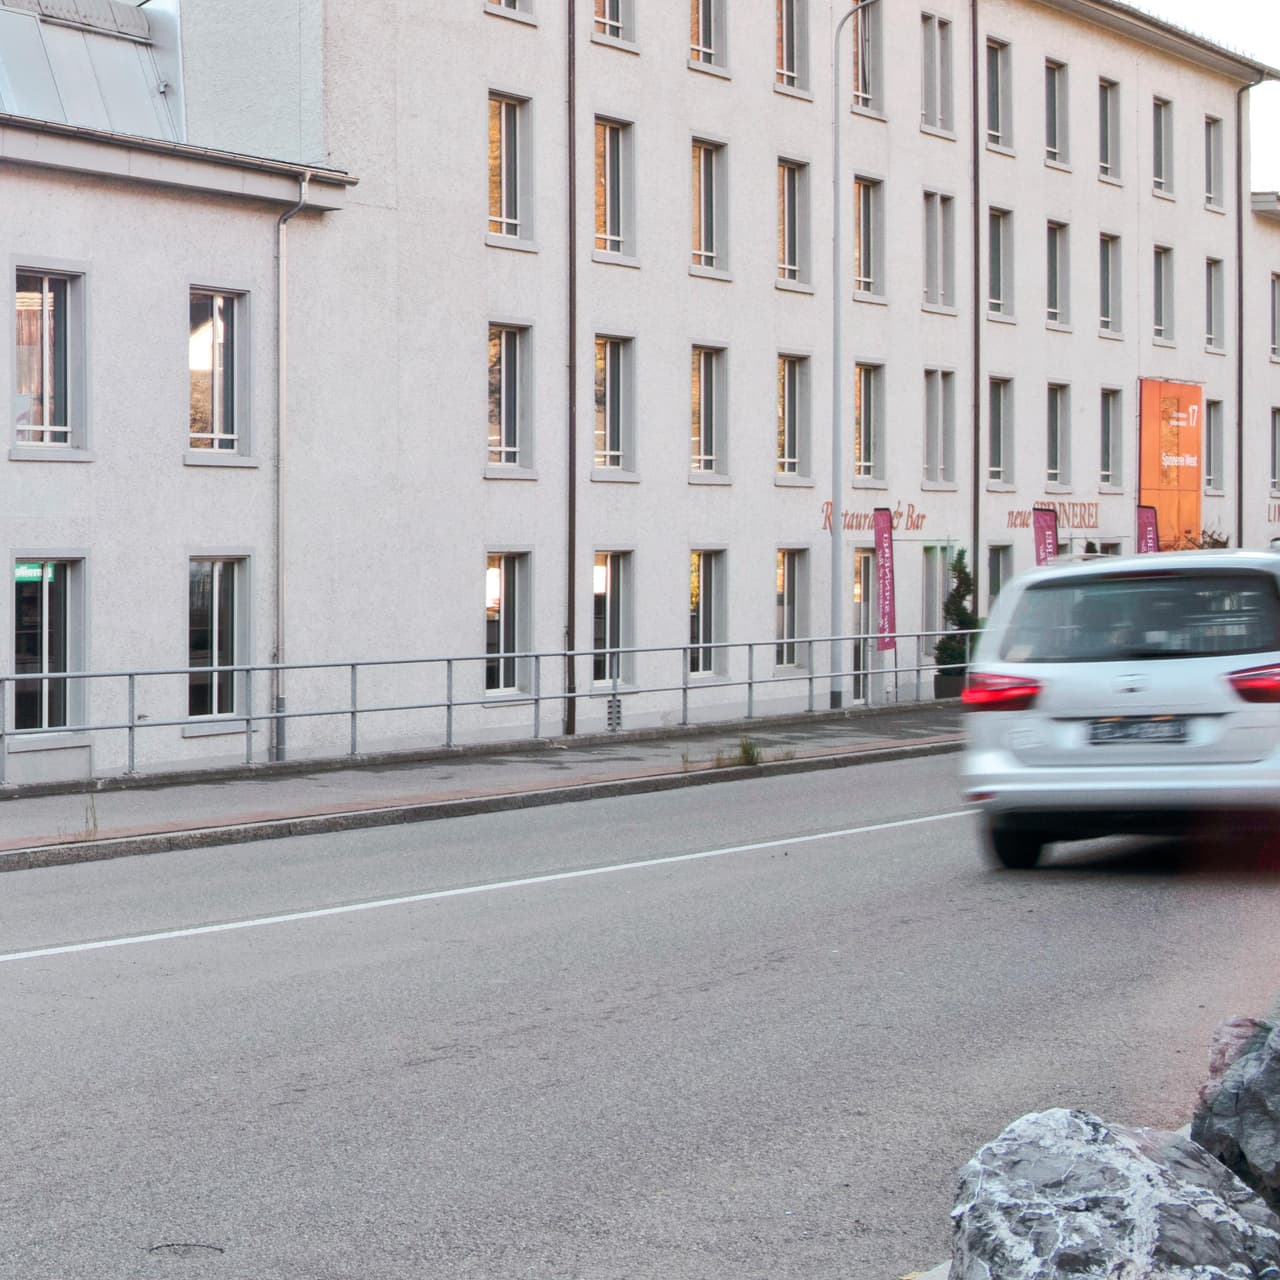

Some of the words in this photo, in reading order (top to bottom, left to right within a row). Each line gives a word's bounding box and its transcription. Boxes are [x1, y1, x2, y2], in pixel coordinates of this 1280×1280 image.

[1188, 404, 1198, 427] 17
[904, 503, 927, 531] Bar
[1007, 510, 1032, 528] neue
